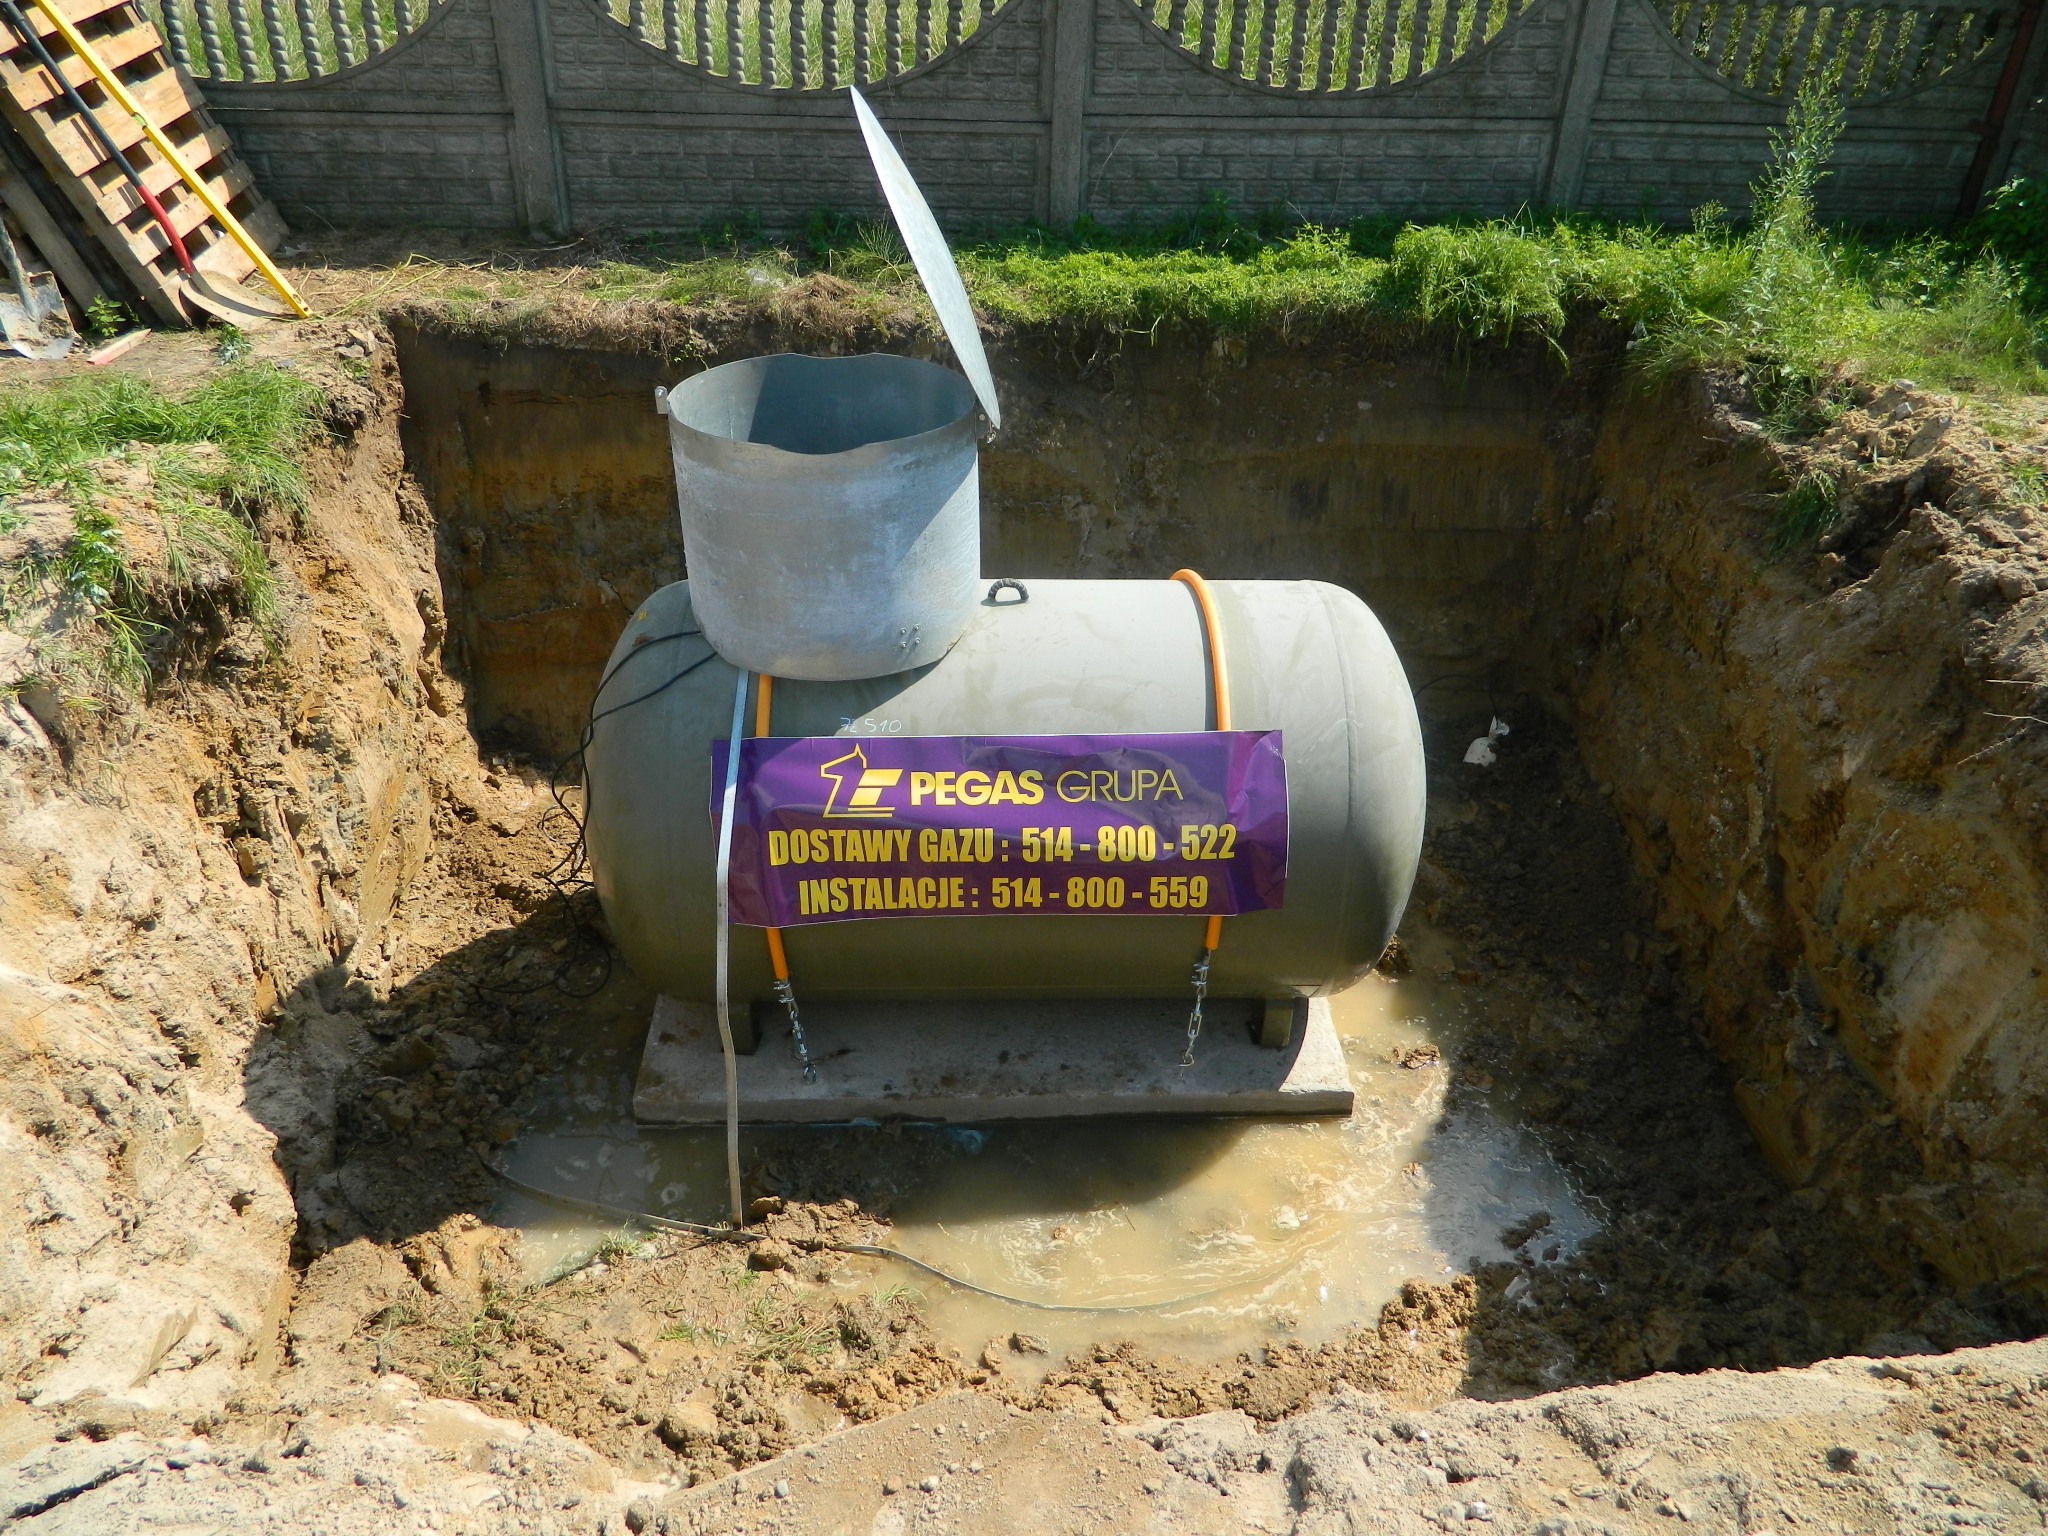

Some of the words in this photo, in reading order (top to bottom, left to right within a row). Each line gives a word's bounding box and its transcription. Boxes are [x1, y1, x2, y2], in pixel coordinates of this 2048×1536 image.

[864, 718, 902, 733] 510
[910, 769, 1045, 806] PEGAS
[1056, 769, 1184, 803] GRUPA
[768, 828, 912, 866] DOSTAWY
[919, 827, 994, 863] GAZU
[799, 876, 964, 915] INSTALACJE
